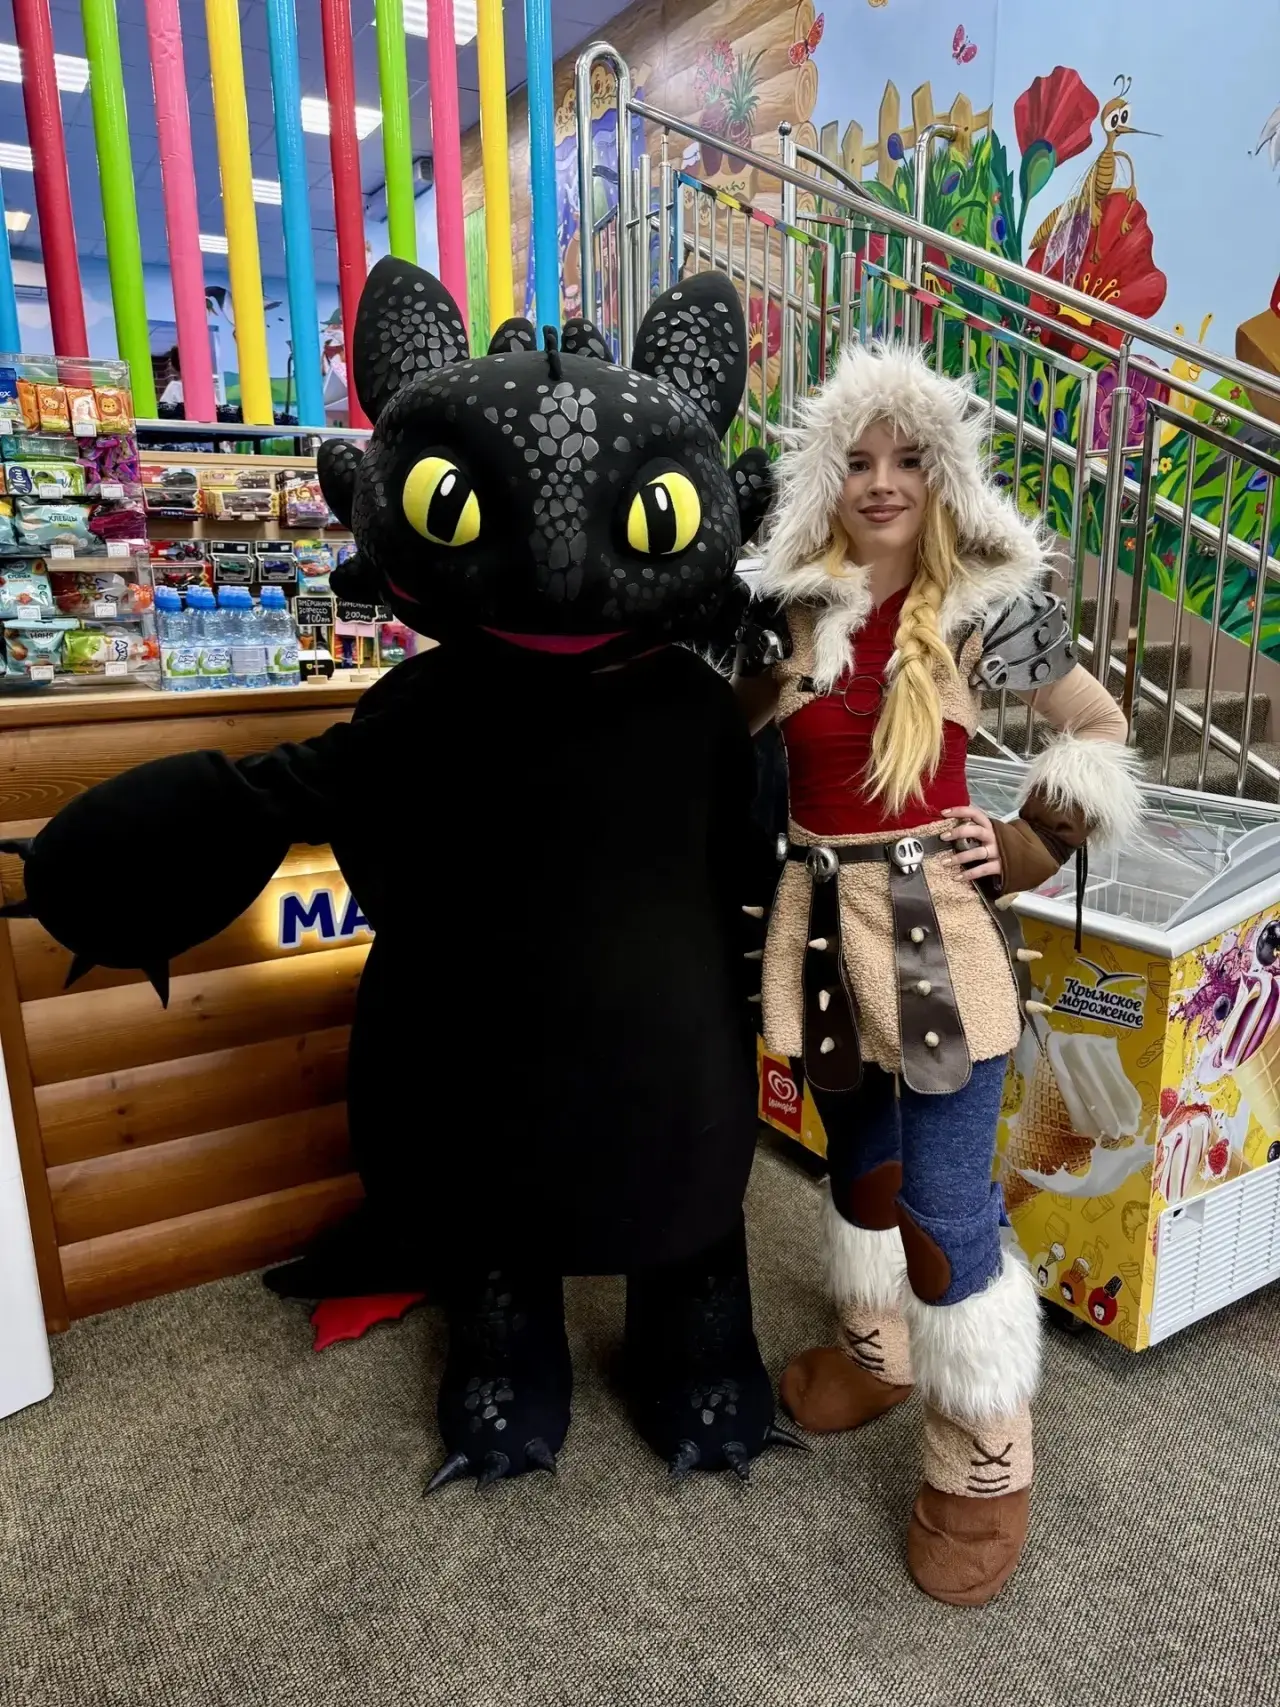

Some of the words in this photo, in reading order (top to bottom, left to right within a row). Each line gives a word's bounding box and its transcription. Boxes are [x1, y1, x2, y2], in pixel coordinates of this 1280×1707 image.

[345, 611, 361, 619] 200
[1058, 994, 1144, 1026] мороженое
[1064, 977, 1143, 1012] Крымское
